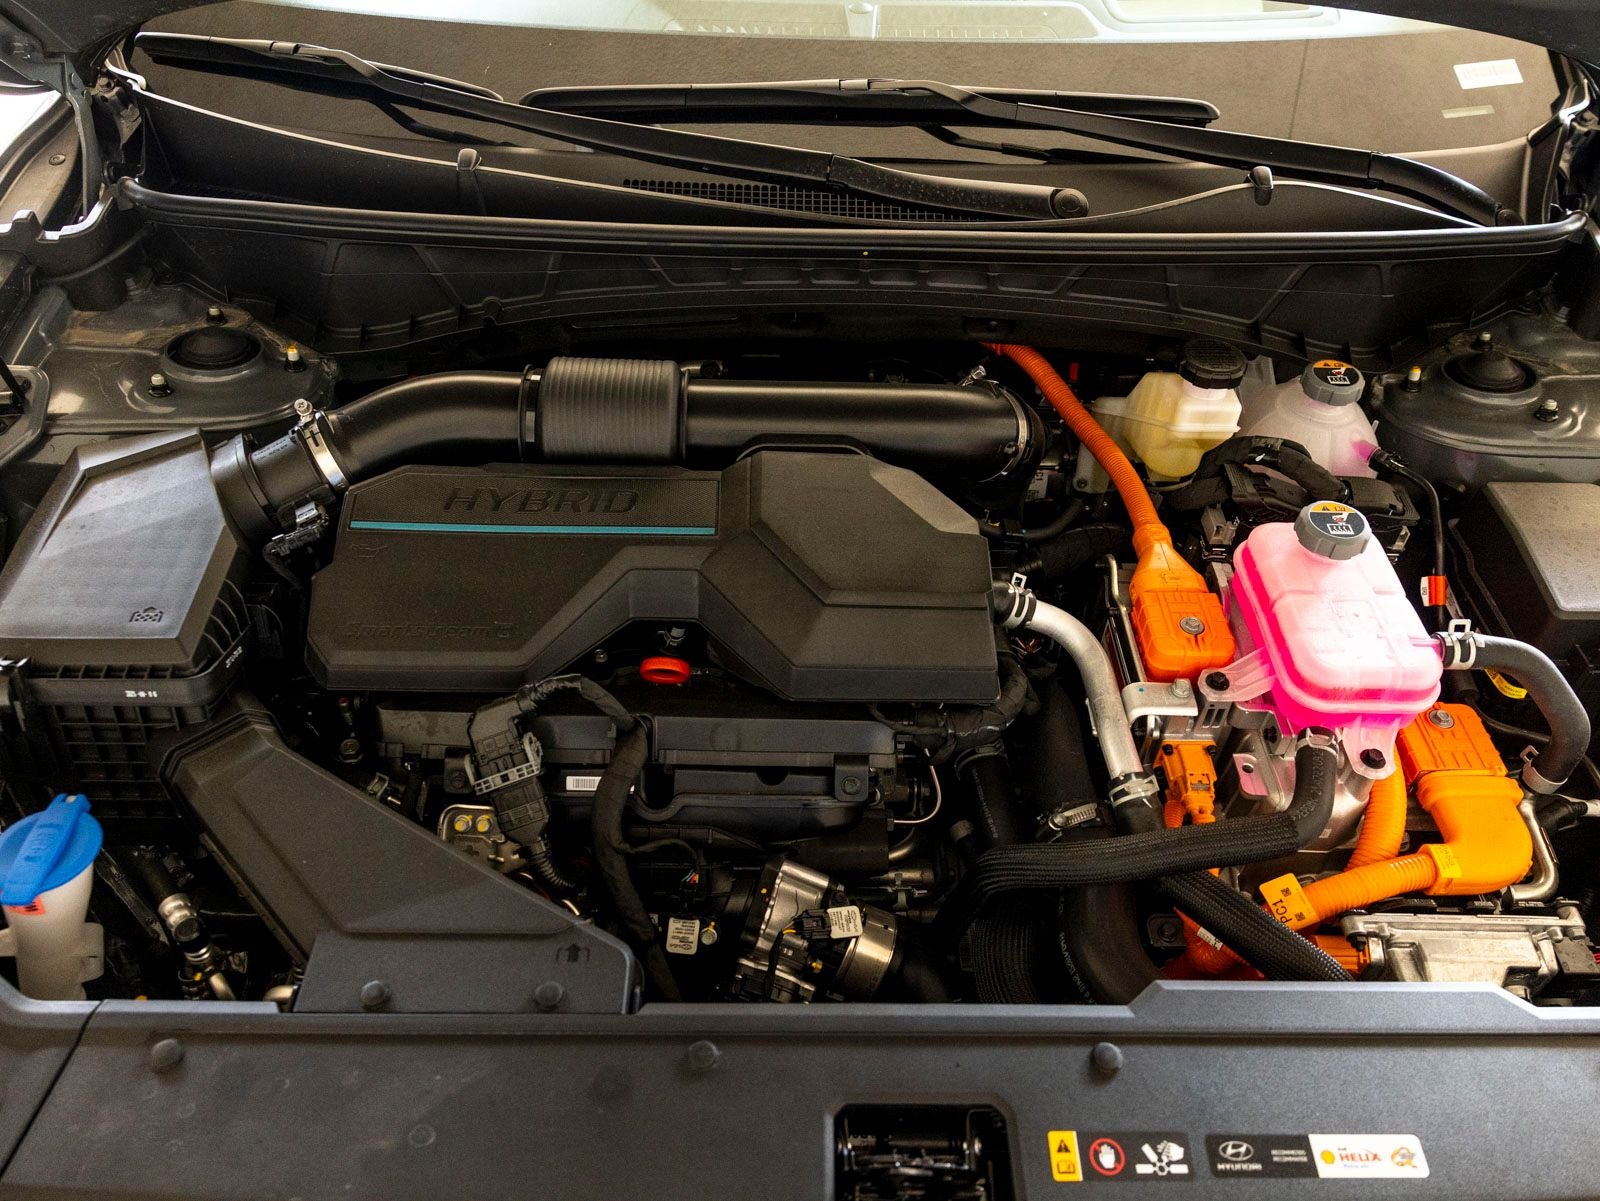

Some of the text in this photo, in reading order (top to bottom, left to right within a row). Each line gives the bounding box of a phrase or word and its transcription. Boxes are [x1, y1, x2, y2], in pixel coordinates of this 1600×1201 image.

[444, 487, 640, 514] HYBRID
[1272, 899, 1293, 924] PC1
[1339, 1152, 1382, 1162] HELIX
[1217, 1163, 1262, 1171] HYUNDAI
